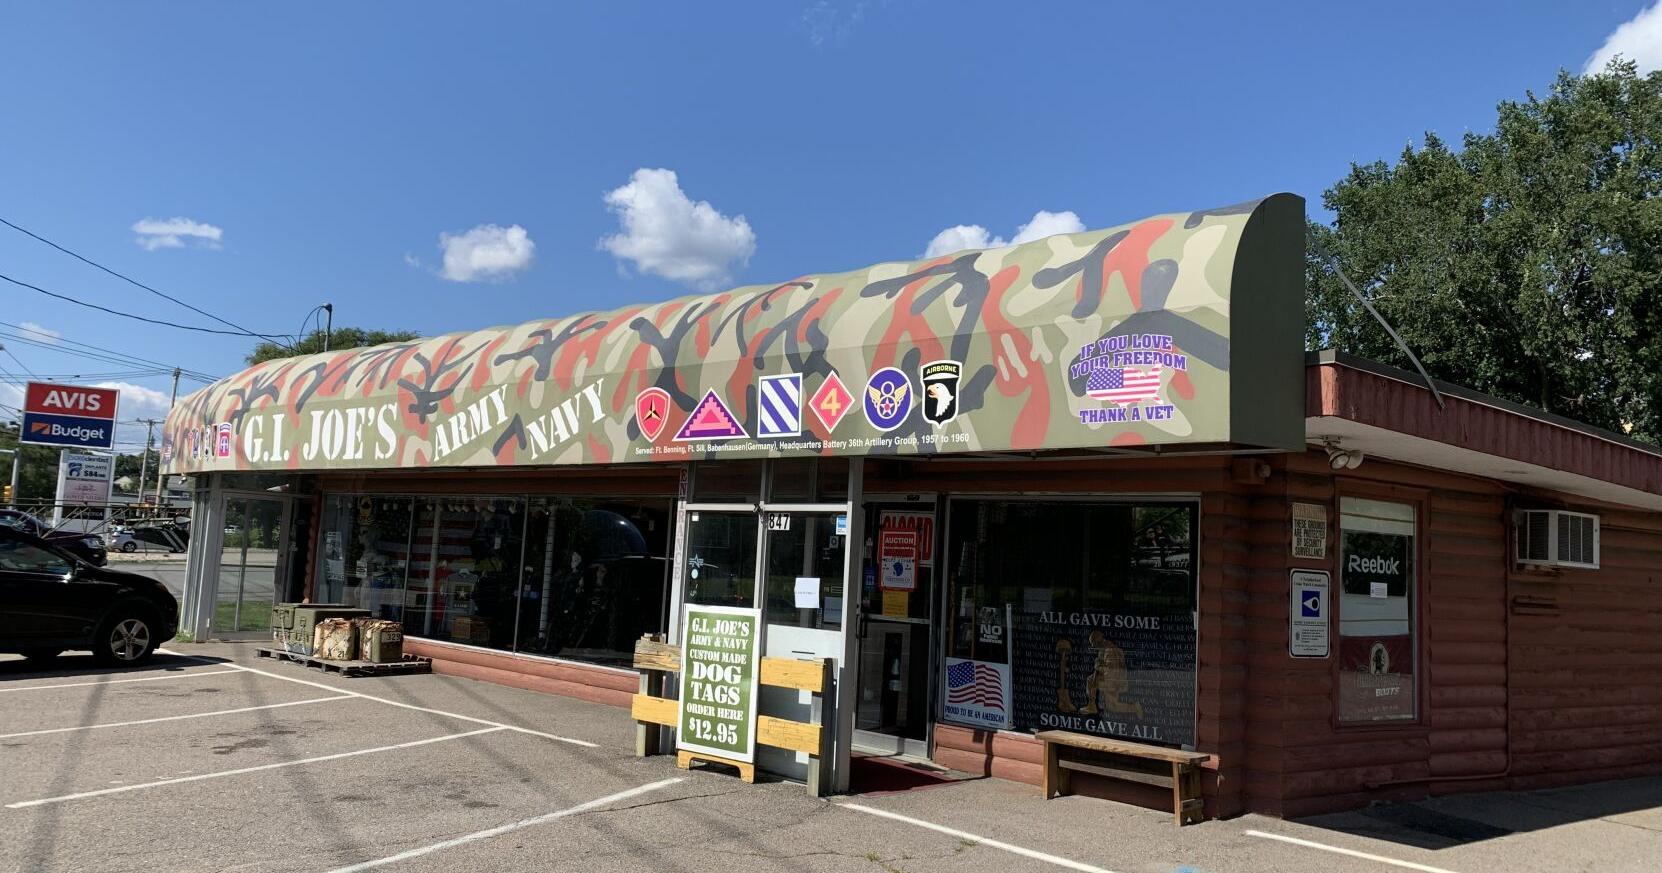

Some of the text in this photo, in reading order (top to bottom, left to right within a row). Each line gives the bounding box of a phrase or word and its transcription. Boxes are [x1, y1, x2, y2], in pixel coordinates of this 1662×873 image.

[1080, 334, 1172, 360] IF YOU LOVE
[926, 365, 957, 374] AIRBORNE
[1071, 351, 1187, 379] YOUR FREEDOM
[42, 390, 101, 411] AVIS
[821, 388, 841, 416] 4
[433, 383, 509, 462] ARMY
[526, 378, 606, 460] NAVY
[1080, 405, 1174, 423] THANK A VET
[51, 424, 104, 441] Budget
[244, 402, 398, 463] G.I. JOE'S
[779, 440, 821, 450] Headquarters
[823, 440, 847, 449] Battery
[848, 439, 863, 447] 36th
[864, 438, 893, 447] Artillery
[894, 436, 919, 446] Group,
[922, 434, 939, 444] 1957
[941, 435, 949, 443] to
[951, 433, 969, 442] 1960
[769, 513, 790, 529] 847
[1348, 554, 1400, 575] Reebok
[691, 617, 750, 637] G.I. JOE'S
[980, 624, 1002, 635] NO
[1039, 611, 1160, 630] ALL GAVE SOME
[690, 634, 748, 650] ARMY & NAVY
[689, 649, 747, 664] CUSTOM MADE
[691, 661, 742, 684] DOG
[690, 681, 740, 705] TAGS
[686, 702, 743, 721] ORDER HERE
[945, 705, 1005, 723] PROUD TO BE AN AMERICAN
[689, 717, 738, 745] $12.95
[1040, 713, 1163, 741] SOME GAVE ALL
